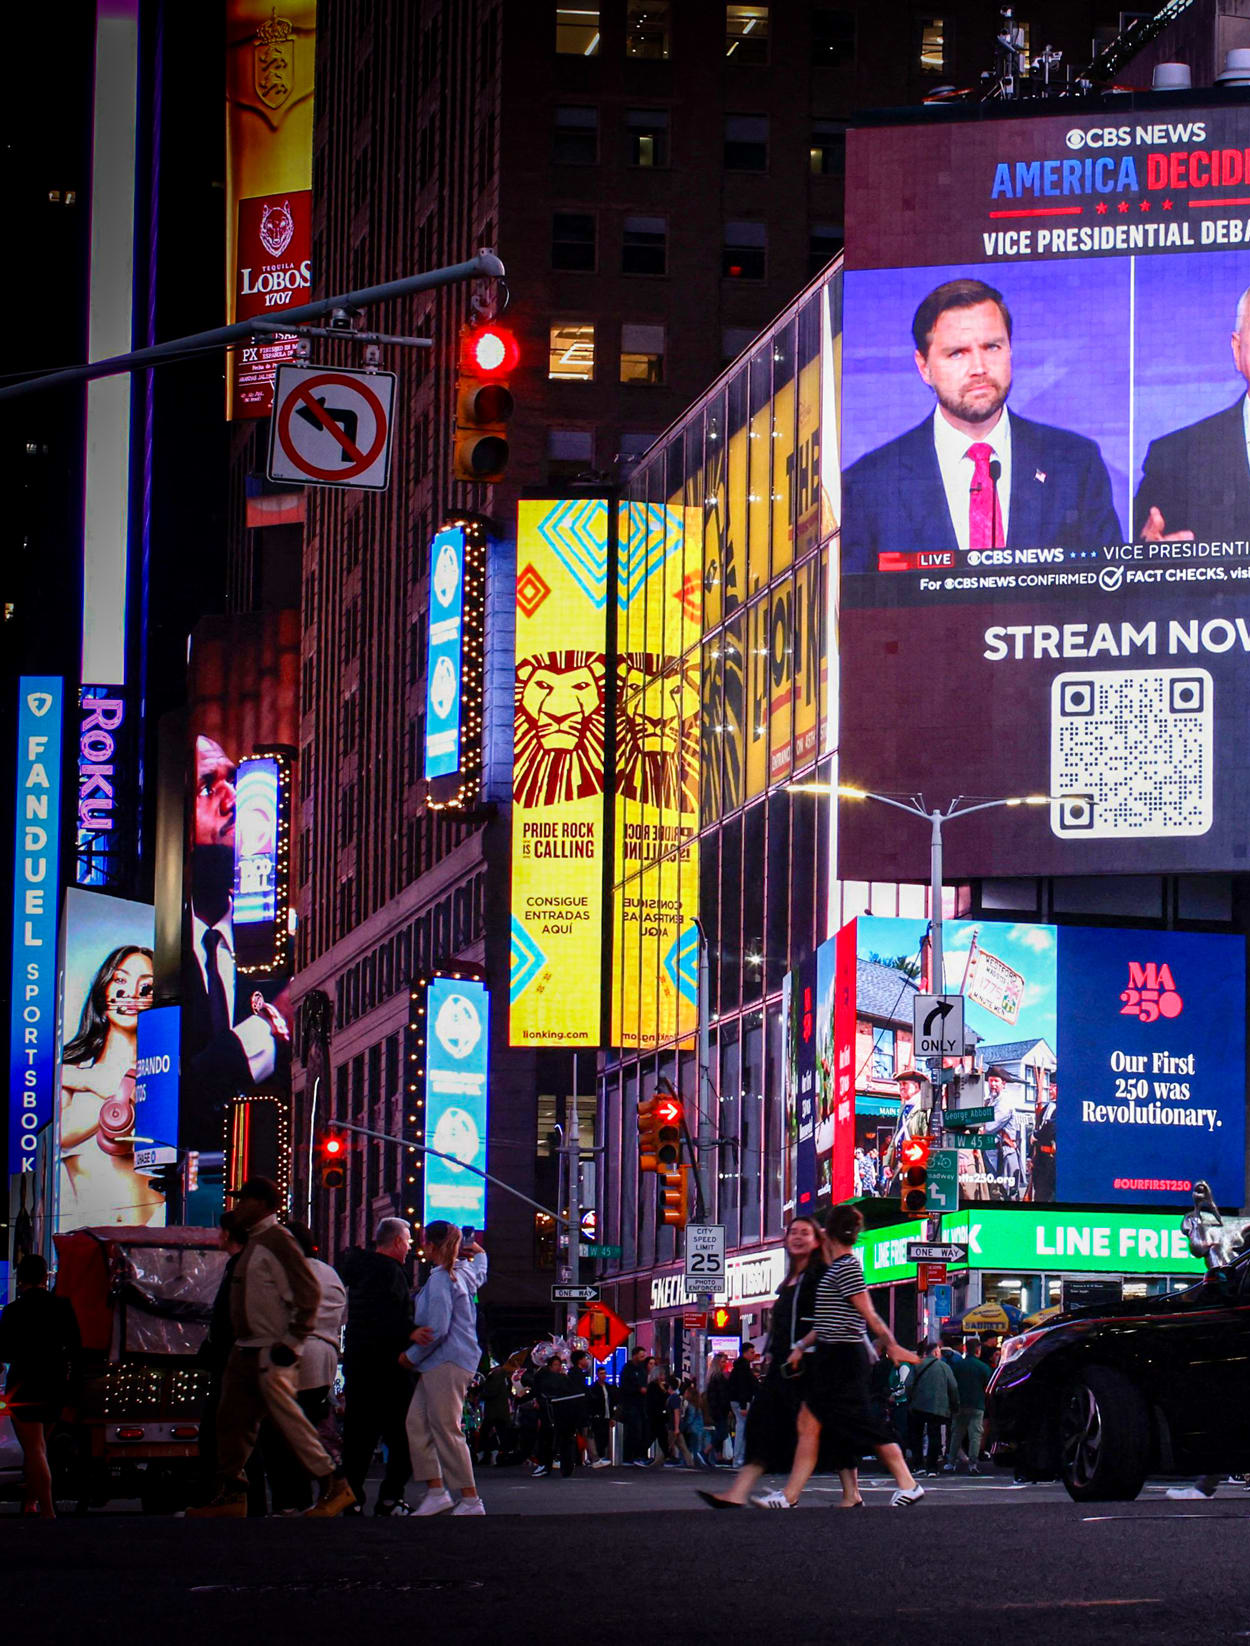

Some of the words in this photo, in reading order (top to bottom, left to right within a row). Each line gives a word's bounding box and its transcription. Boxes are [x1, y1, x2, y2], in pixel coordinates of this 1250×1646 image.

[1087, 127, 1131, 147] CBS
[1135, 122, 1206, 145] NEWS
[991, 156, 1139, 199] AMERICA
[983, 231, 1031, 256] VICE
[1037, 222, 1194, 253] PRESIDENTIAL
[240, 260, 311, 294] LOBOS
[262, 263, 294, 272] TEQUILA
[265, 291, 292, 306] 1707
[242, 348, 258, 361] PX
[921, 554, 951, 566] LIVE
[981, 550, 1013, 564] CBS
[1015, 548, 1064, 564] NEWS
[1104, 545, 1143, 560] VICE
[920, 578, 942, 591] For
[955, 577, 978, 589] CBS
[980, 576, 1016, 588] NEWS
[1018, 573, 1097, 587] CONFIRMED
[1127, 570, 1163, 583] FACT
[1165, 567, 1228, 581] CHECKS,
[983, 621, 1157, 660] STREAM
[523, 823, 558, 838] PRIDE
[562, 823, 594, 838] ROCK
[25, 736, 50, 946] FANDUEL
[523, 843, 531, 855] IS
[534, 840, 594, 858] CALLING
[526, 897, 588, 907] CONSIGUE
[525, 911, 590, 920] ENTRADAS
[542, 923, 573, 934] AQUÍ
[1127, 961, 1176, 990] MA
[1119, 990, 1183, 1022] 250
[523, 1030, 588, 1040] lionking.com
[921, 1040, 956, 1052] ONLY
[21, 963, 40, 1173] SPORTSBOOK
[1110, 1050, 1148, 1074] Our
[1152, 1051, 1195, 1076] First
[1115, 1078, 1149, 1099] 250
[1153, 1081, 1190, 1101] was
[945, 1112, 968, 1121] George
[1082, 1101, 1222, 1131] Revolutionary.
[957, 1135, 966, 1147] W
[971, 1135, 983, 1148] 45
[1113, 1178, 1191, 1191] #OURFIRST250
[590, 1247, 597, 1255] W
[602, 1247, 611, 1255] 45
[1036, 1226, 1110, 1256] LINE
[1119, 1228, 1194, 1258] FRIE
[915, 1248, 933, 1257] ONE
[941, 1249, 959, 1257] WAY
[691, 1254, 720, 1272] 25
[650, 1274, 697, 1310] SKECH
